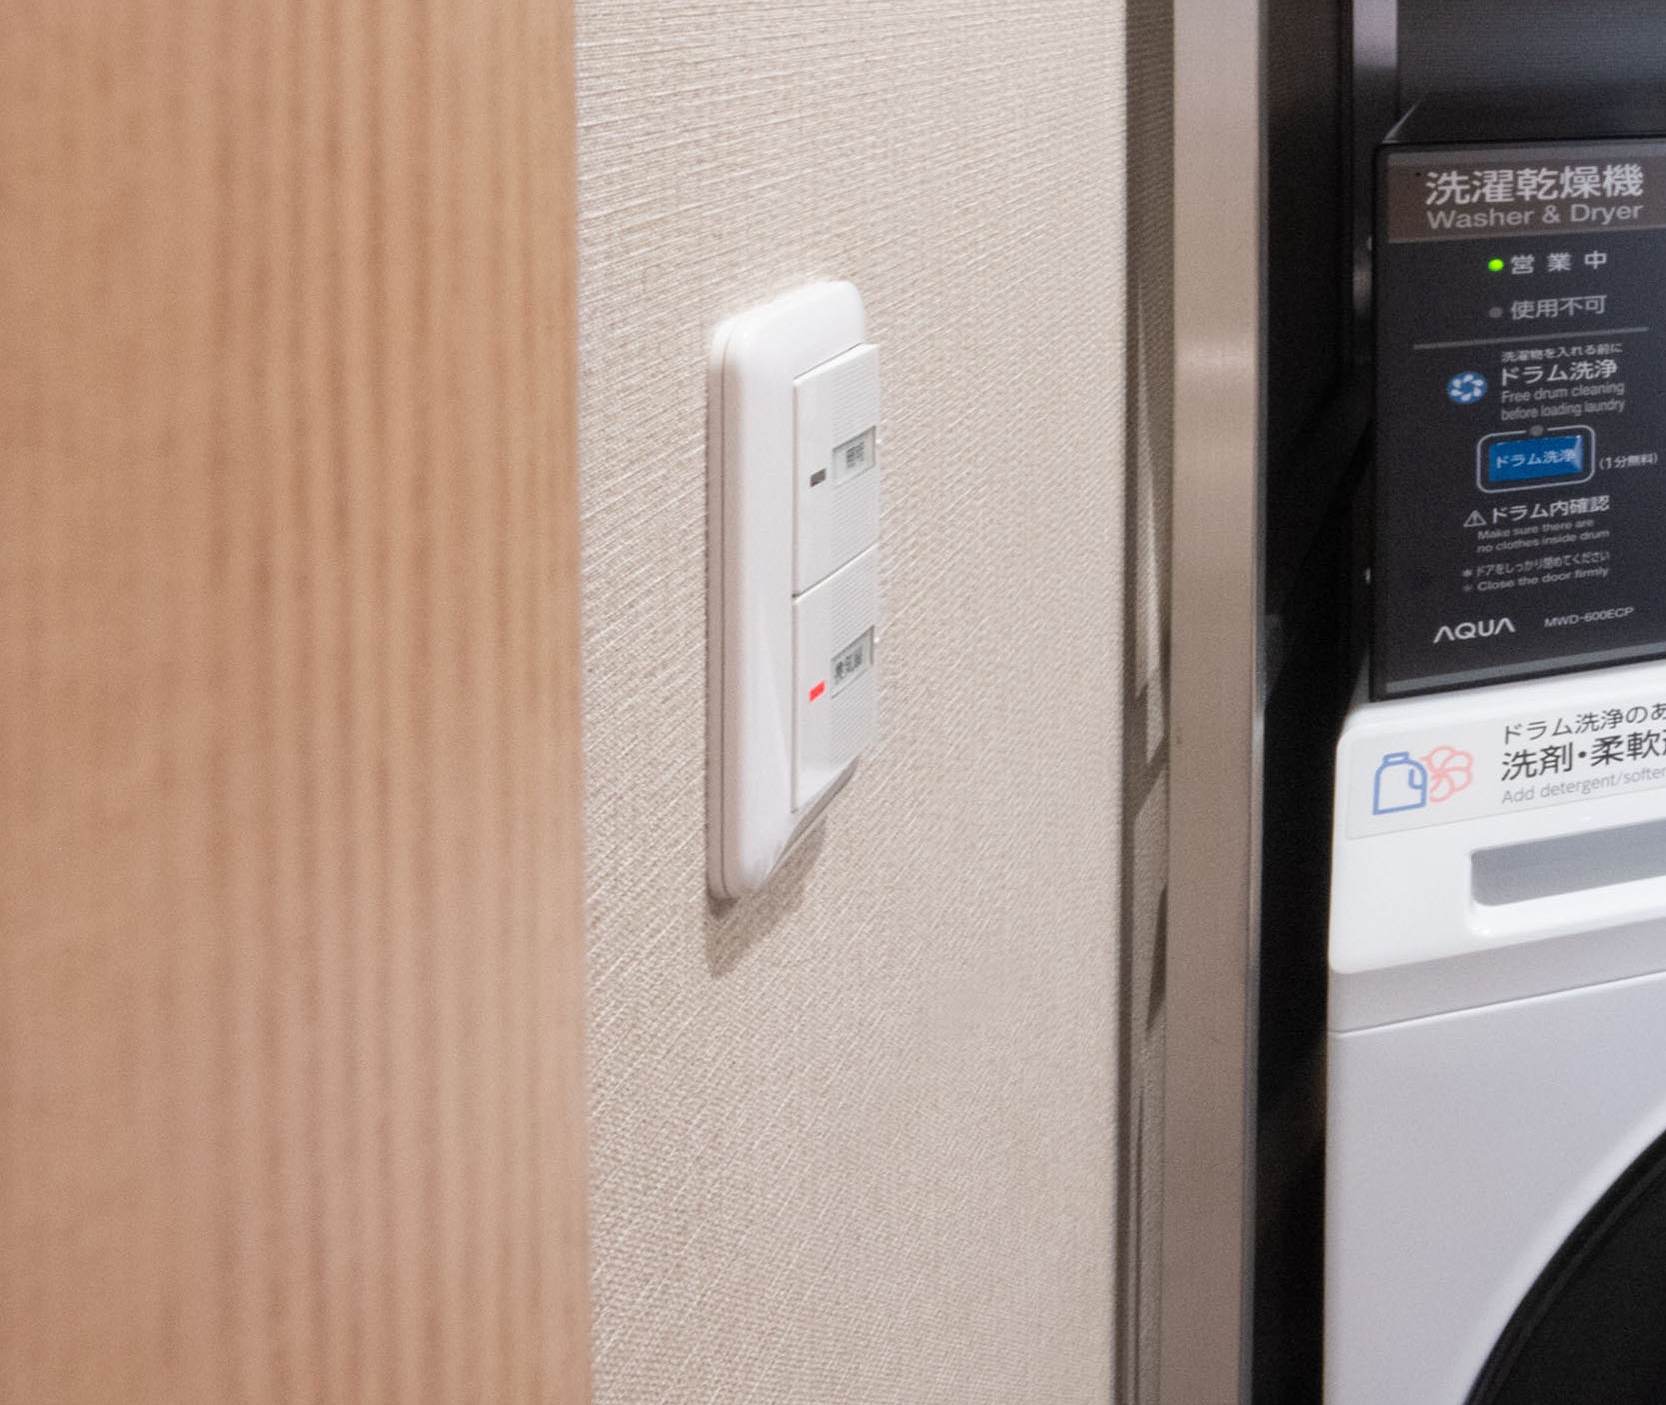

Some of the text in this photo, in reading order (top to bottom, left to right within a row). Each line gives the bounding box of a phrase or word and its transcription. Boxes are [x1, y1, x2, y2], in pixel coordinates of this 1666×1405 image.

[1425, 163, 1645, 206] 洗濯乾燥機
[1427, 202, 1644, 230] Washer & Dryer
[1511, 294, 1608, 321] 使用不可
[1502, 343, 1623, 363] 洗濯物を入れる前に
[1502, 358, 1618, 387] ドラム洗浄
[1501, 381, 1625, 404] Free drum cleaning
[1501, 398, 1625, 421] before loading laundry
[1496, 447, 1577, 469] ドラム洗浄
[1492, 495, 1611, 524] ドラム内確認
[1477, 519, 1572, 540] Make sure there
[1496, 529, 1611, 552] clothes inside drum
[1476, 551, 1611, 578] ドアをしっかり閉めてください
[1477, 566, 1611, 592] Close door firmly
[1544, 606, 1635, 629] MWD-600ECP
[1432, 617, 1516, 645] AQUA
[1501, 787, 1536, 806] Add
